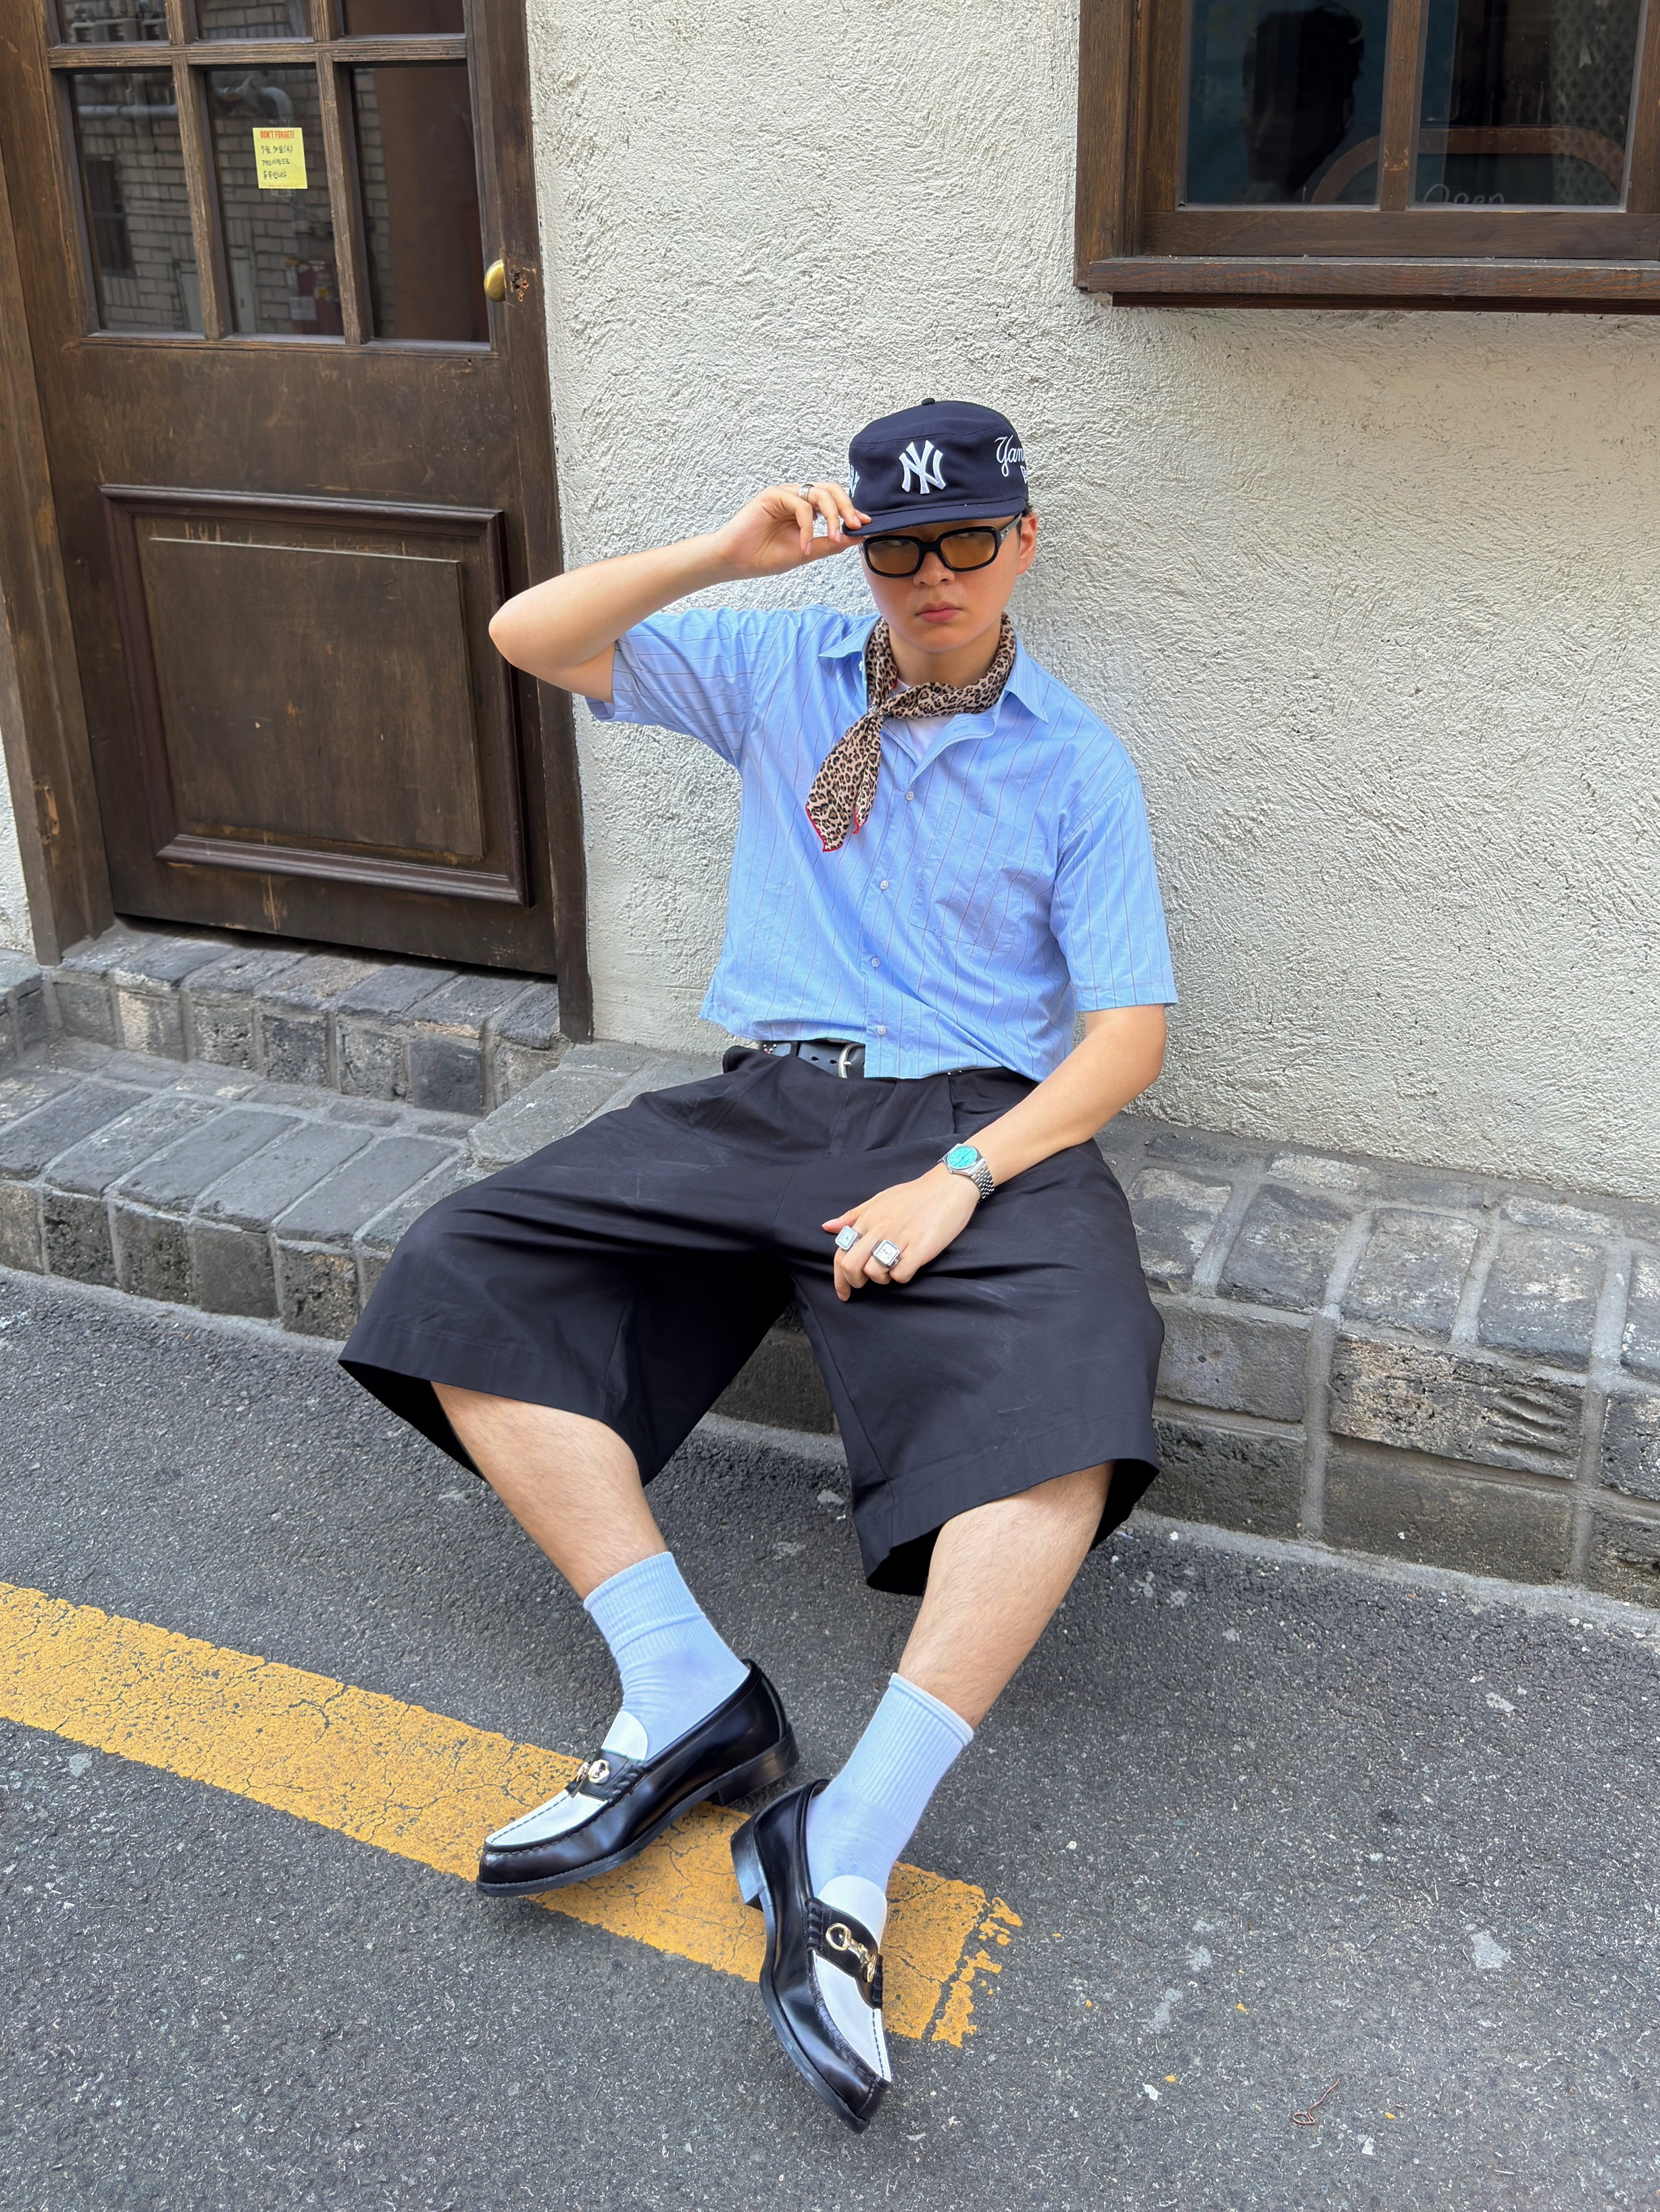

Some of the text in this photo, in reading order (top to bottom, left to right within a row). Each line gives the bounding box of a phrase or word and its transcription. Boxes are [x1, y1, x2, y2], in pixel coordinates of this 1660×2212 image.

[260, 130, 295, 139] DON'T FORGET!
[899, 440, 947, 495] NY
